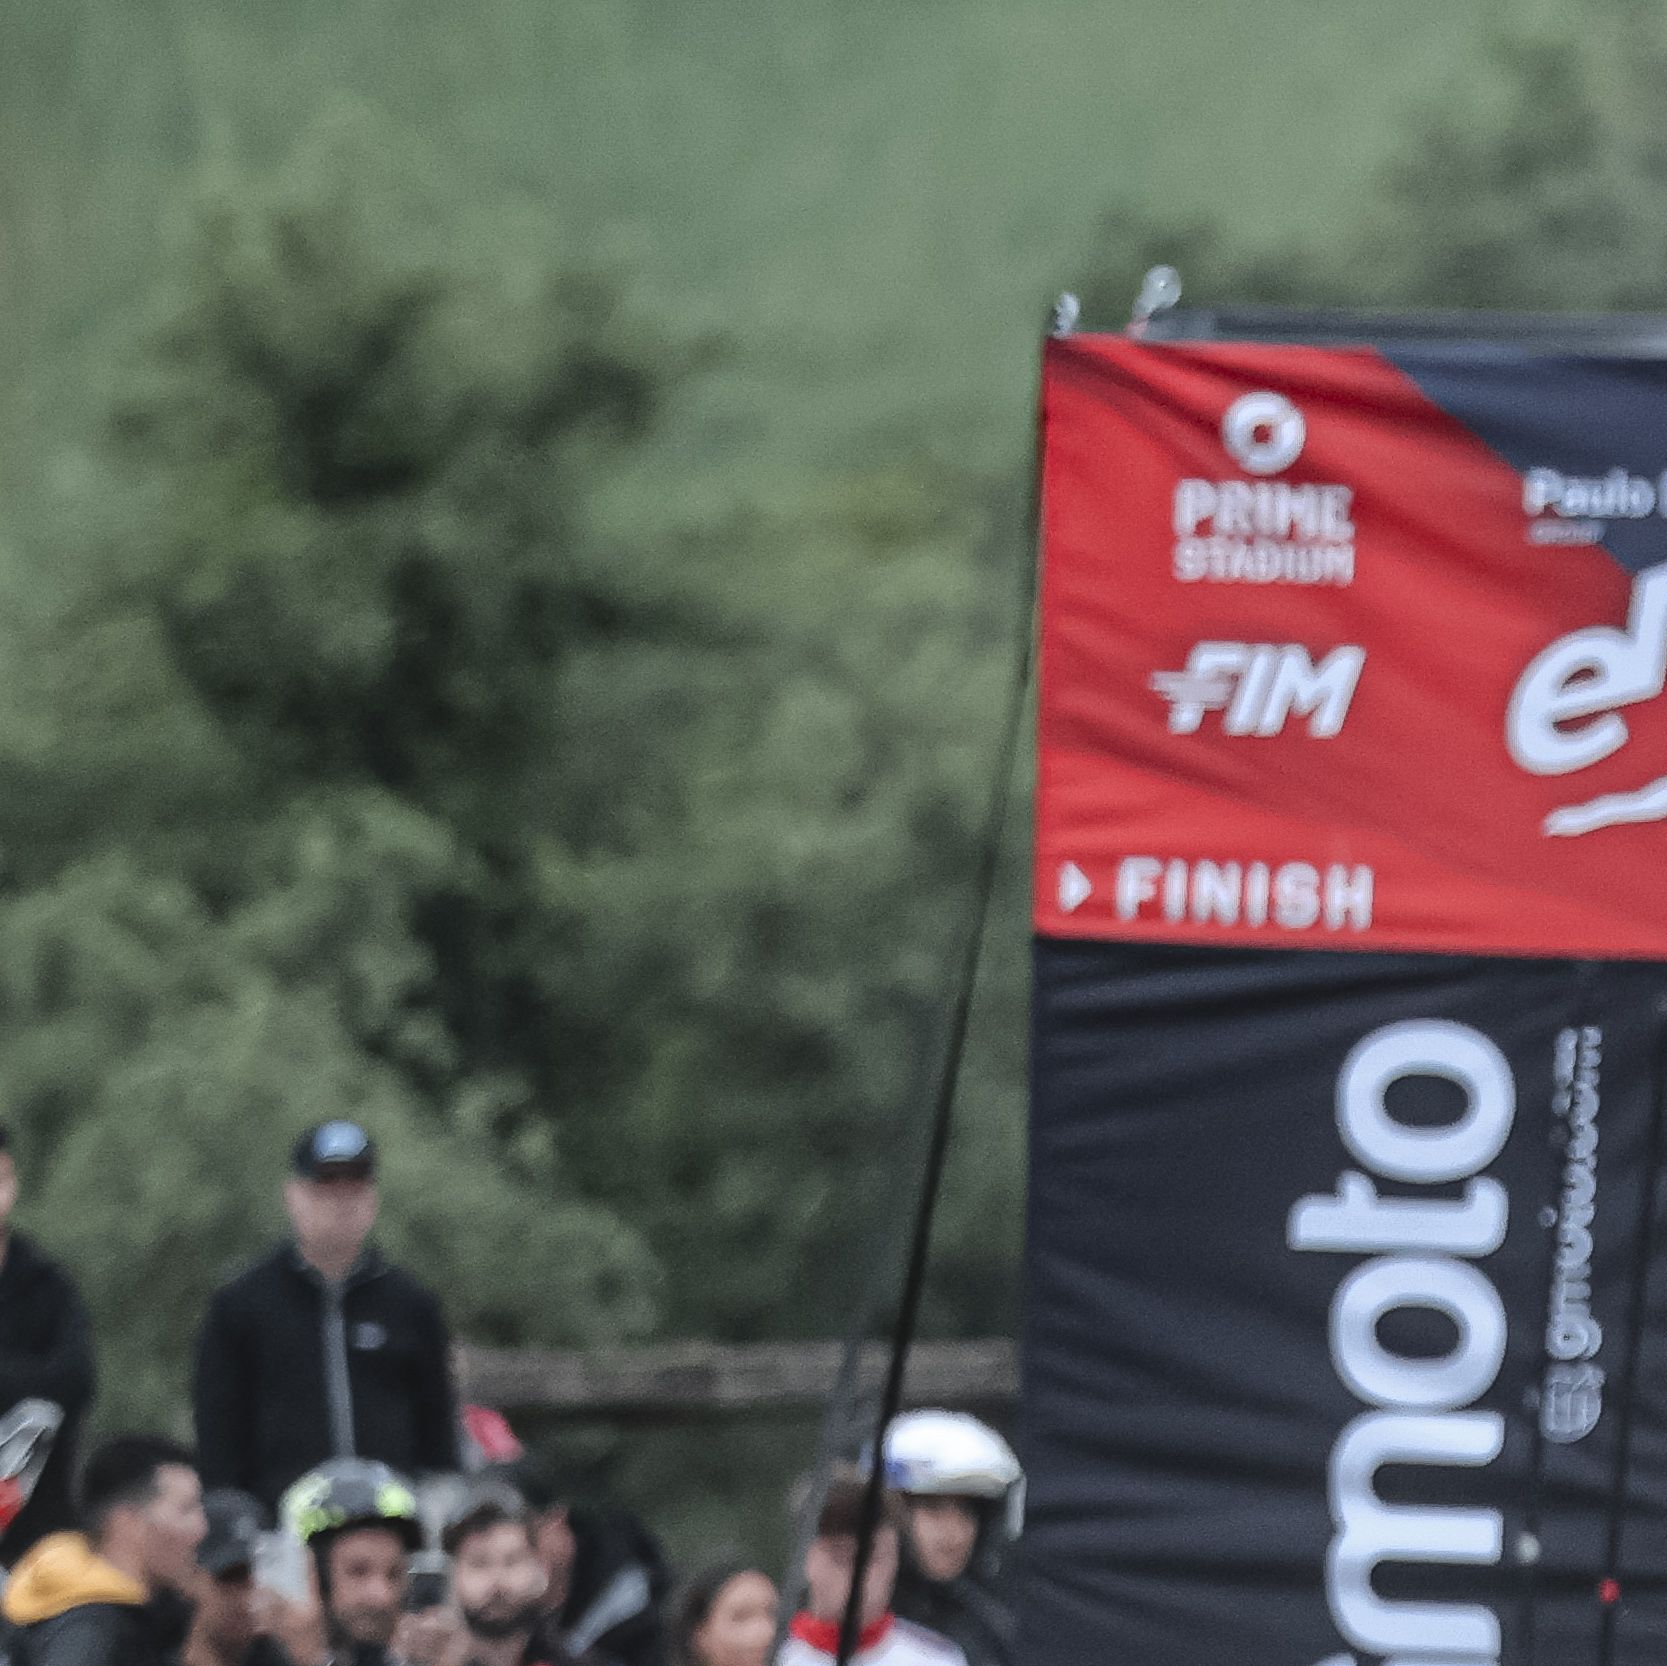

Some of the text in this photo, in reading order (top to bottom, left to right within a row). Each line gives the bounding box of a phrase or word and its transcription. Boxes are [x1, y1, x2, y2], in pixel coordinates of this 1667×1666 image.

[1174, 479, 1354, 541] PRIME
[1523, 467, 1656, 519] Paulo
[1173, 538, 1355, 584] STADIUM
[1150, 642, 1367, 738] FIM
[1115, 856, 1375, 932] FINISH
